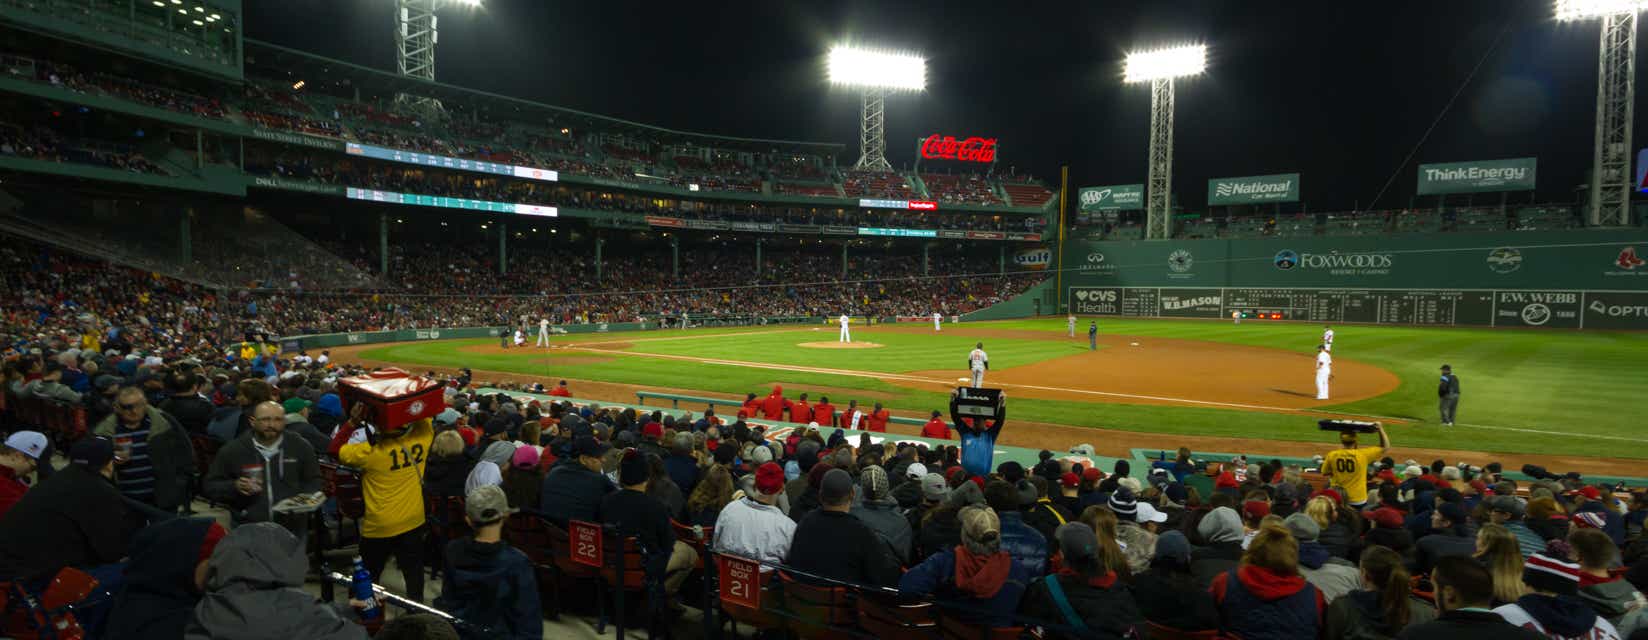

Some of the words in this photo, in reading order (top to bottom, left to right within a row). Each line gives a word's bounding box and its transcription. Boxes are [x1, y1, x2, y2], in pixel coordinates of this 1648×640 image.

[1425, 167, 1525, 181] ThinkEnergy
[255, 177, 277, 187] DELL
[1232, 180, 1291, 195] National
[1014, 252, 1050, 265] Gulf
[1300, 253, 1392, 269] FOXWOODS
[1088, 290, 1117, 301] CVS
[1530, 293, 1577, 304] WEBB
[1077, 301, 1117, 314] Health
[389, 443, 424, 471] 112
[1337, 458, 1355, 473] 00
[578, 542, 597, 558] 22
[727, 559, 753, 573] FIELD
[730, 568, 750, 581] BOX
[731, 580, 749, 600] 21
